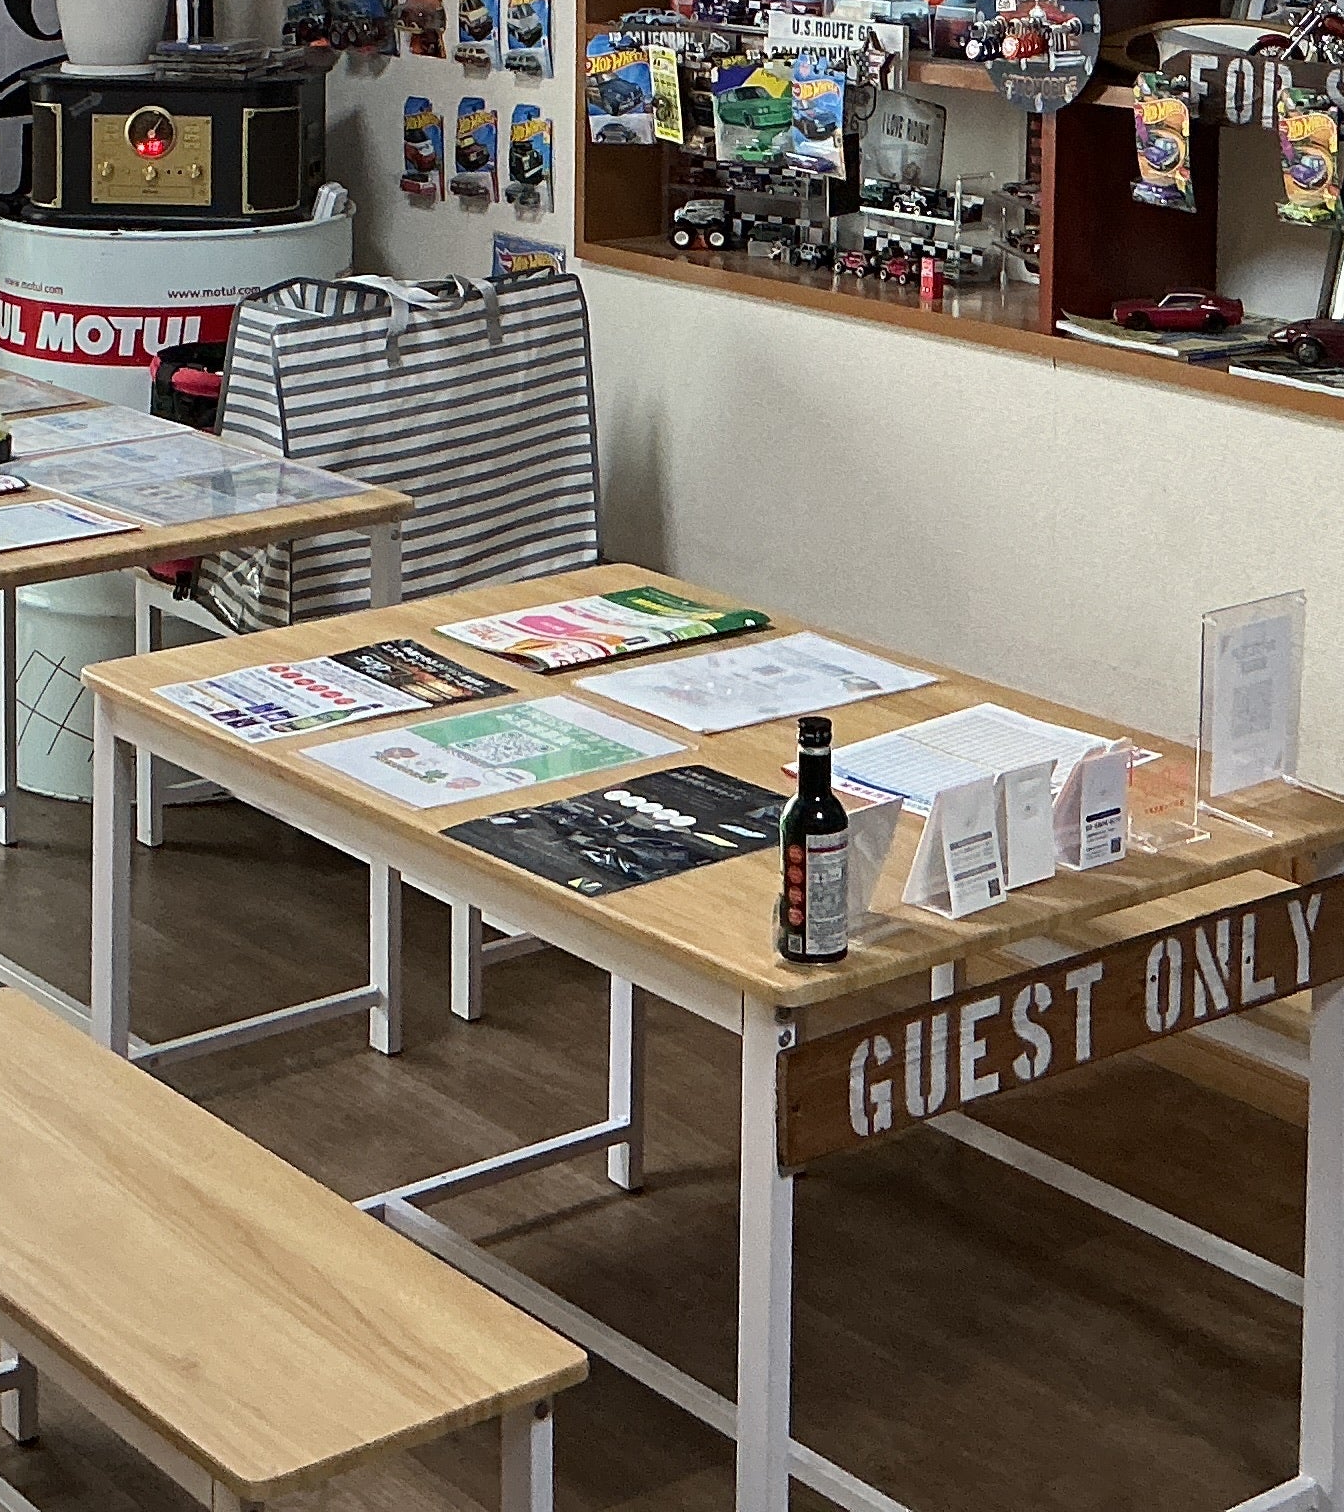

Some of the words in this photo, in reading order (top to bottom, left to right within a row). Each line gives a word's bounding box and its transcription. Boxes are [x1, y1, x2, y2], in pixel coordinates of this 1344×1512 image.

[167, 285, 261, 300] www.motul.com
[36, 309, 202, 357] MOTUL
[848, 959, 1104, 1139] GUEST
[1144, 891, 1322, 1033] ONLY
